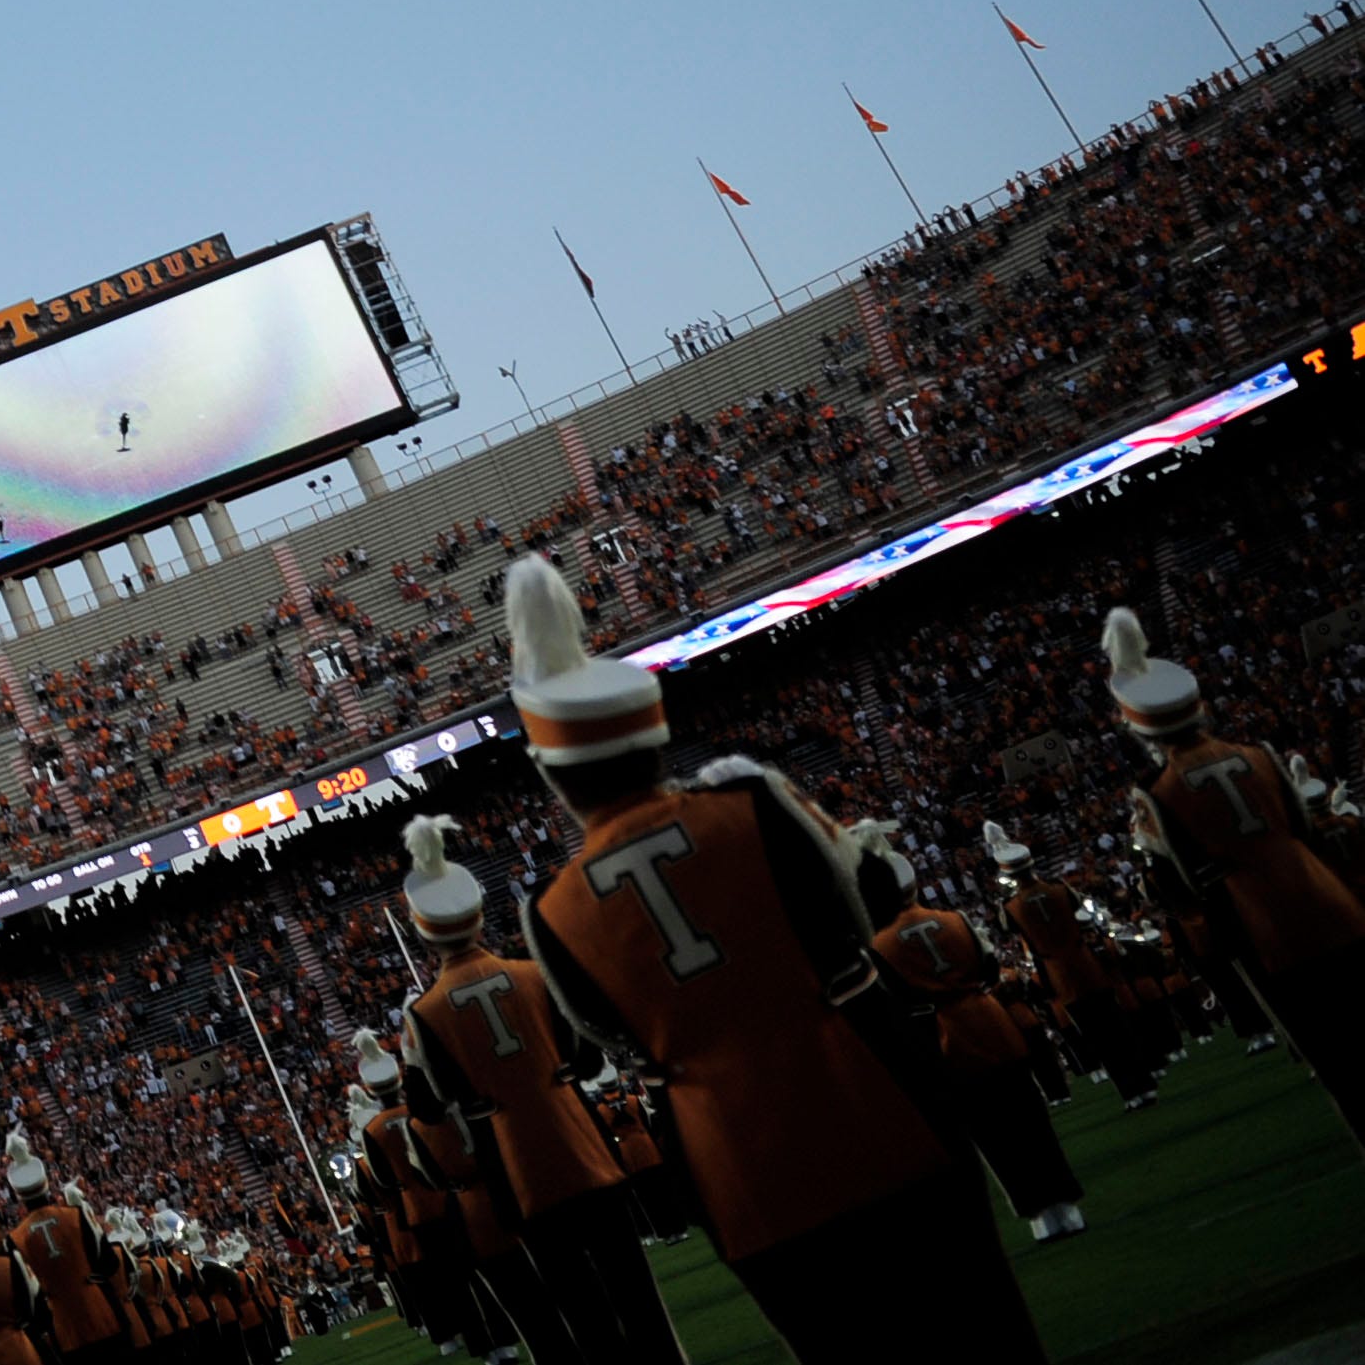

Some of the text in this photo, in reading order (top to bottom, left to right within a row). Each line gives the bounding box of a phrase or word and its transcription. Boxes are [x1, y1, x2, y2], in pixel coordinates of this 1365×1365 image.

[48, 240, 219, 323] STADIUM
[1302, 348, 1328, 374] T
[437, 731, 457, 752] 0
[316, 767, 367, 801] 9:20
[1183, 755, 1268, 836] T
[222, 791, 286, 833] 0 T
[72, 855, 115, 877] BALL ON
[129, 842, 152, 857] QTR
[138, 852, 153, 867] 1
[31, 873, 62, 891] TO GO
[584, 823, 727, 981] T
[899, 920, 951, 974] T
[449, 972, 526, 1058] T
[30, 1218, 63, 1259] T
